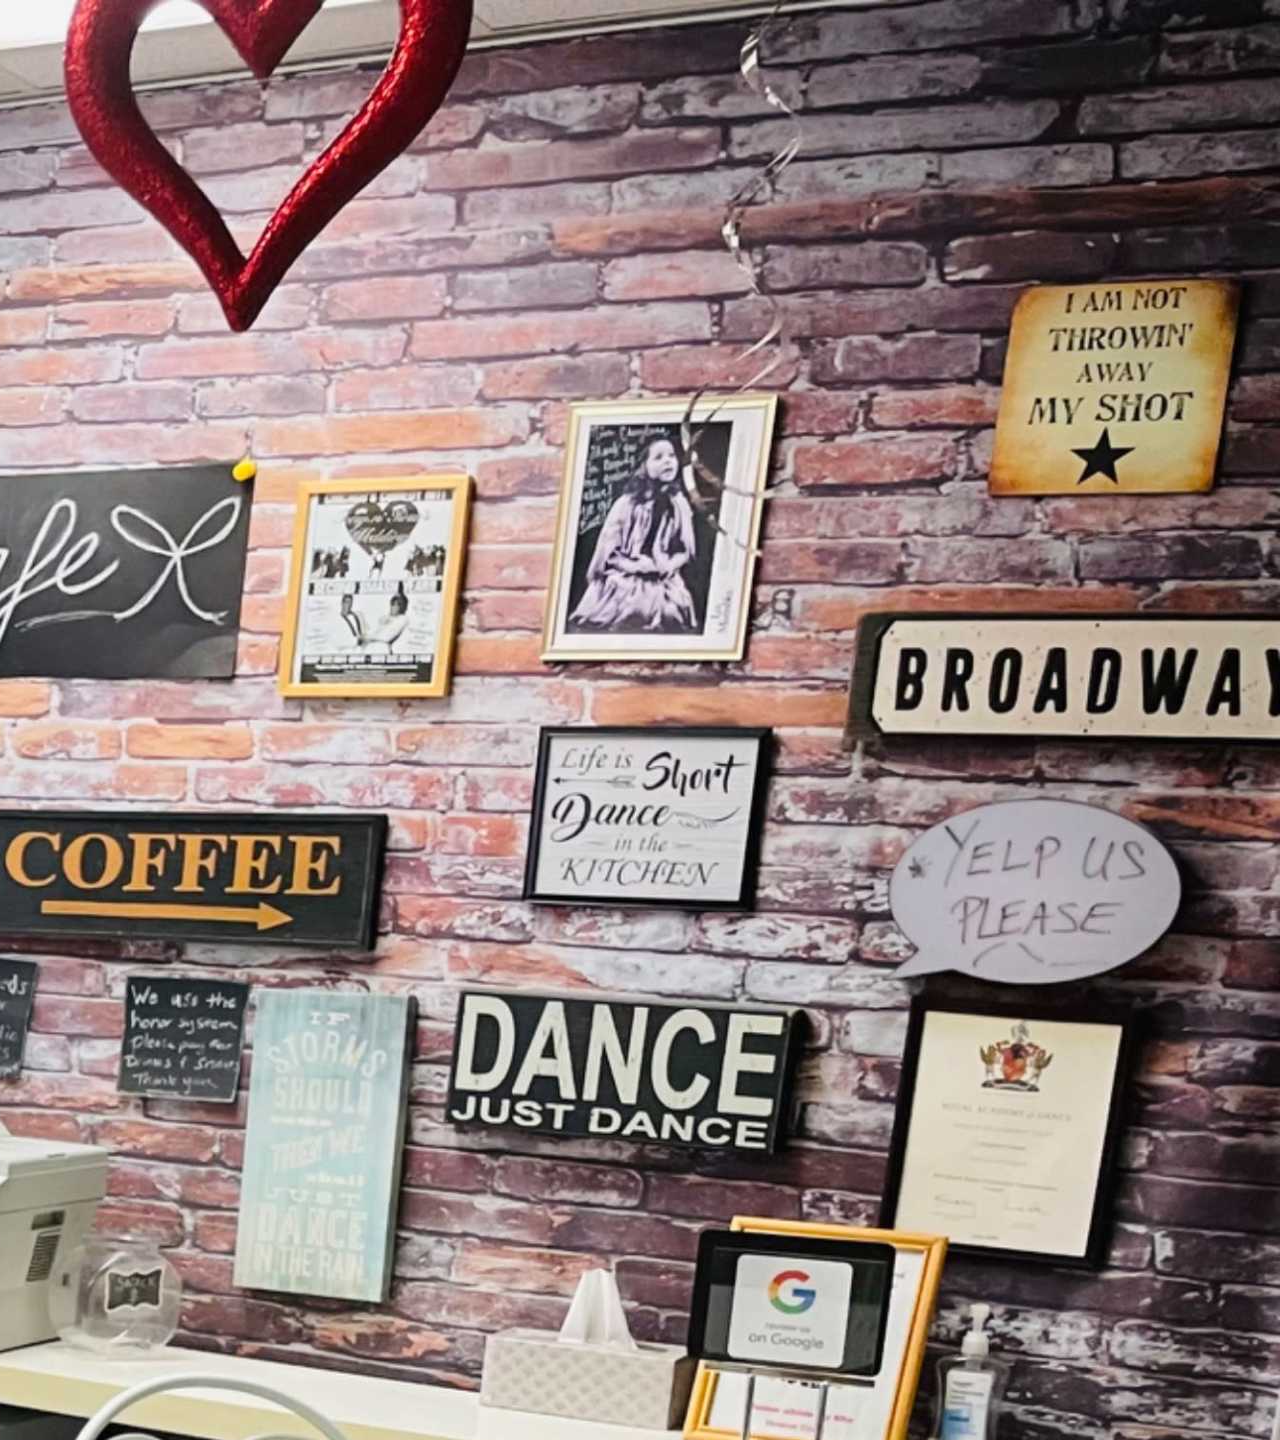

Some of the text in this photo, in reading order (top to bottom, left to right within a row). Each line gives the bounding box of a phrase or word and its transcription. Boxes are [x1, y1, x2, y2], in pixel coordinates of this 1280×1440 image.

[1064, 286, 1188, 314] I AM NOT
[1048, 322, 1194, 352] THROWIN'
[1076, 361, 1153, 384] AWAY
[1028, 391, 1195, 425] MY SHOT
[560, 745, 750, 797] Life is Short
[551, 792, 672, 843] Dance
[614, 832, 668, 852] in the
[941, 819, 1146, 888] YELP US
[4, 831, 342, 896] COFFEE
[560, 857, 720, 887] KITCHEN
[951, 896, 1124, 944] PLEASE
[130, 984, 159, 1006] We
[205, 991, 237, 1009] the
[130, 1009, 174, 1029] honor
[309, 1010, 352, 1026] IF
[266, 1029, 388, 1079] STORMS
[454, 994, 785, 1118] DANCE
[132, 1071, 219, 1095] Thank you
[273, 1076, 373, 1118] SHOULD
[451, 1096, 769, 1149] JUST DANCE
[257, 1202, 369, 1252] DANCE
[748, 1332, 825, 1351] on Google
